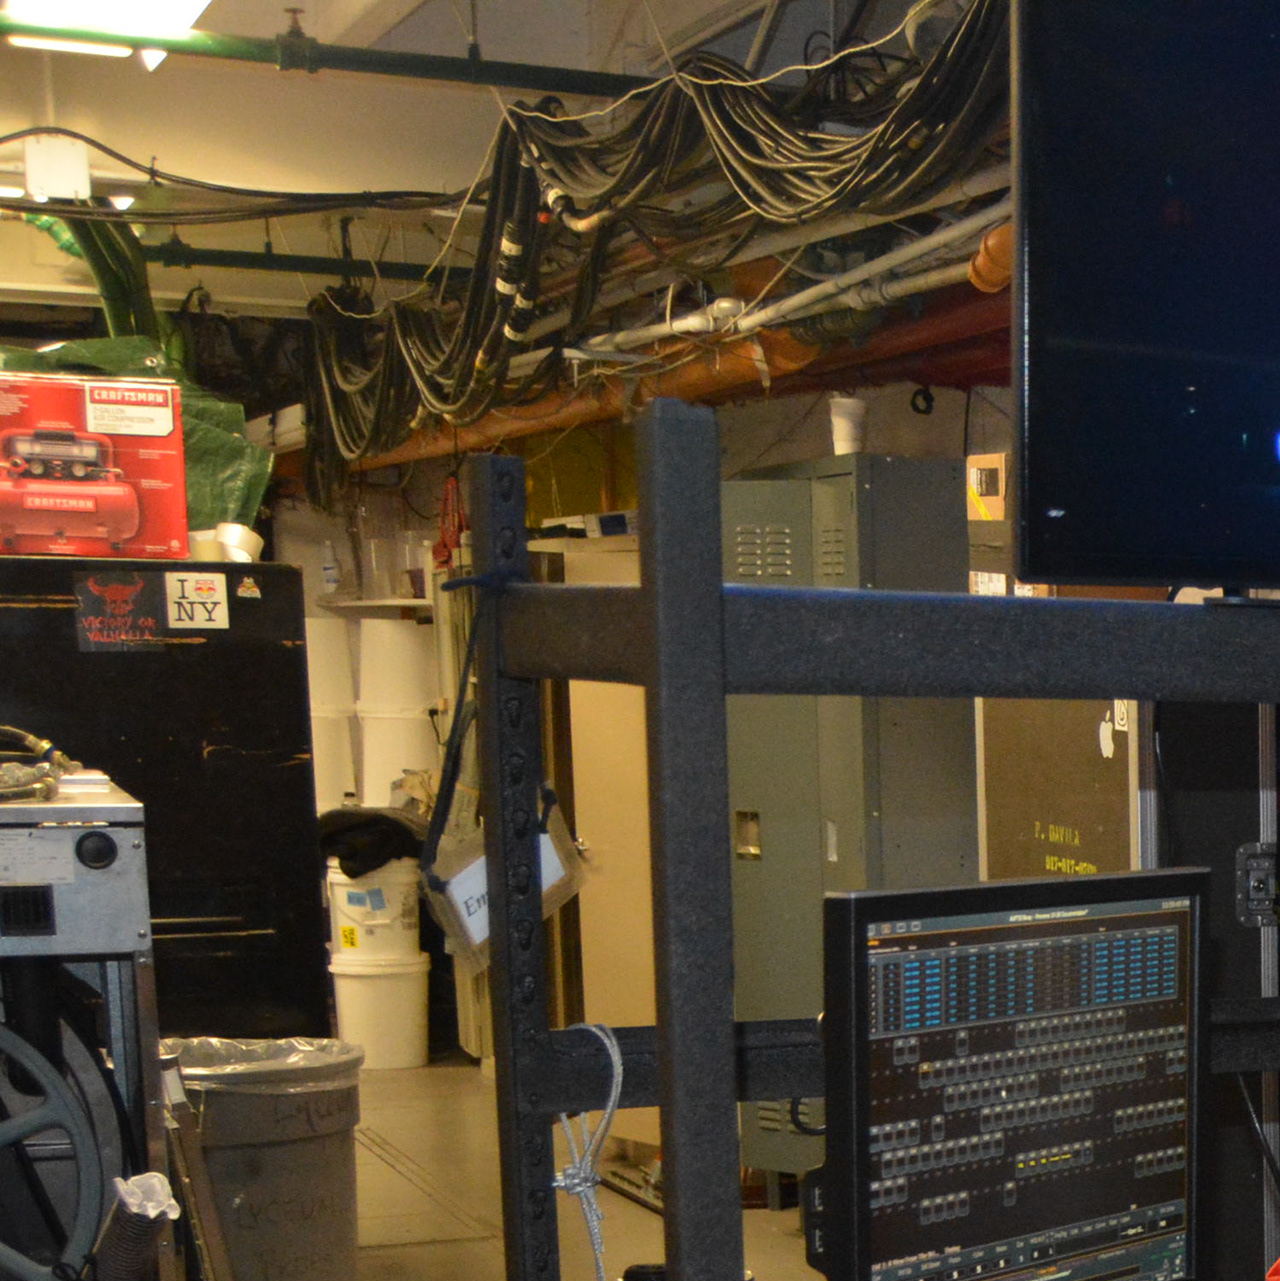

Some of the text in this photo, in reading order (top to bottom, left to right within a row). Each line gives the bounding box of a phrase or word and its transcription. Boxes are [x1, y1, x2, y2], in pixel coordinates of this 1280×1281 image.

[94, 390, 164, 402] CRAFTSMAN
[26, 497, 94, 508] CRAFTSMAN
[178, 579, 189, 599] I
[174, 602, 221, 622] NY
